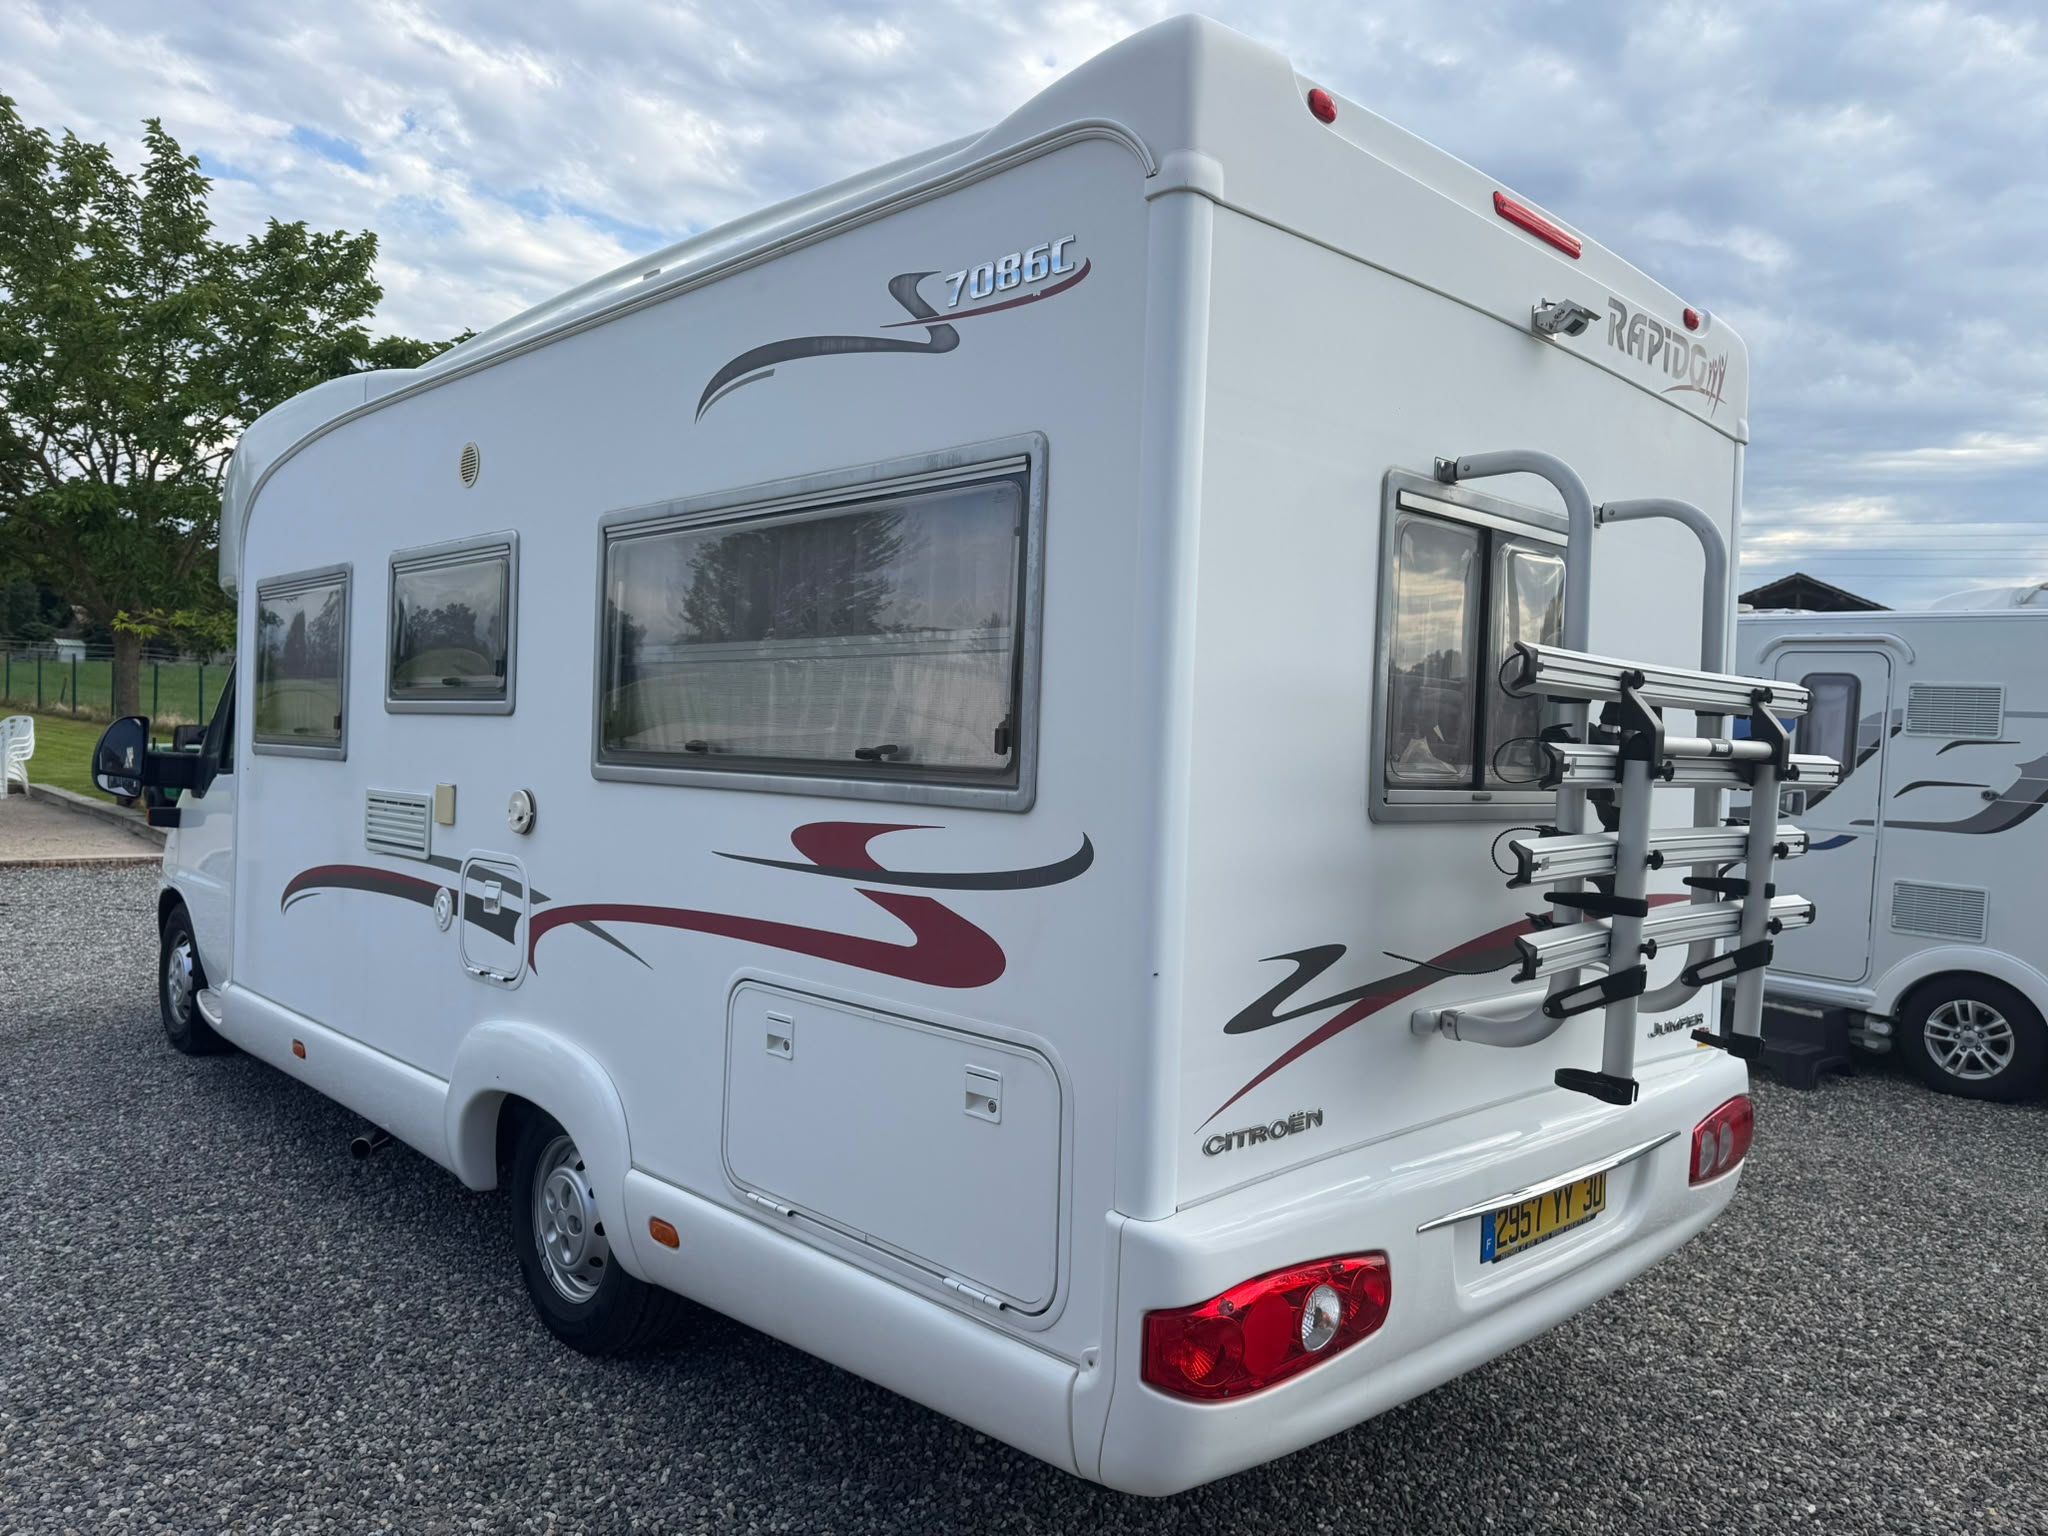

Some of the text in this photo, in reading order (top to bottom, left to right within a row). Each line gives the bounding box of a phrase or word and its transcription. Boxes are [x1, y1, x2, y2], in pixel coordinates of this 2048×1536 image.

[945, 234, 1075, 308] 7086C
[1647, 1013, 1704, 1039] JUMPER
[1202, 1108, 1324, 1157] CITROËN
[1496, 1197, 1544, 1250] 2957
[1553, 1185, 1574, 1224] YY
[1583, 1173, 1603, 1212] 30
[1486, 1237, 1492, 1251] F
